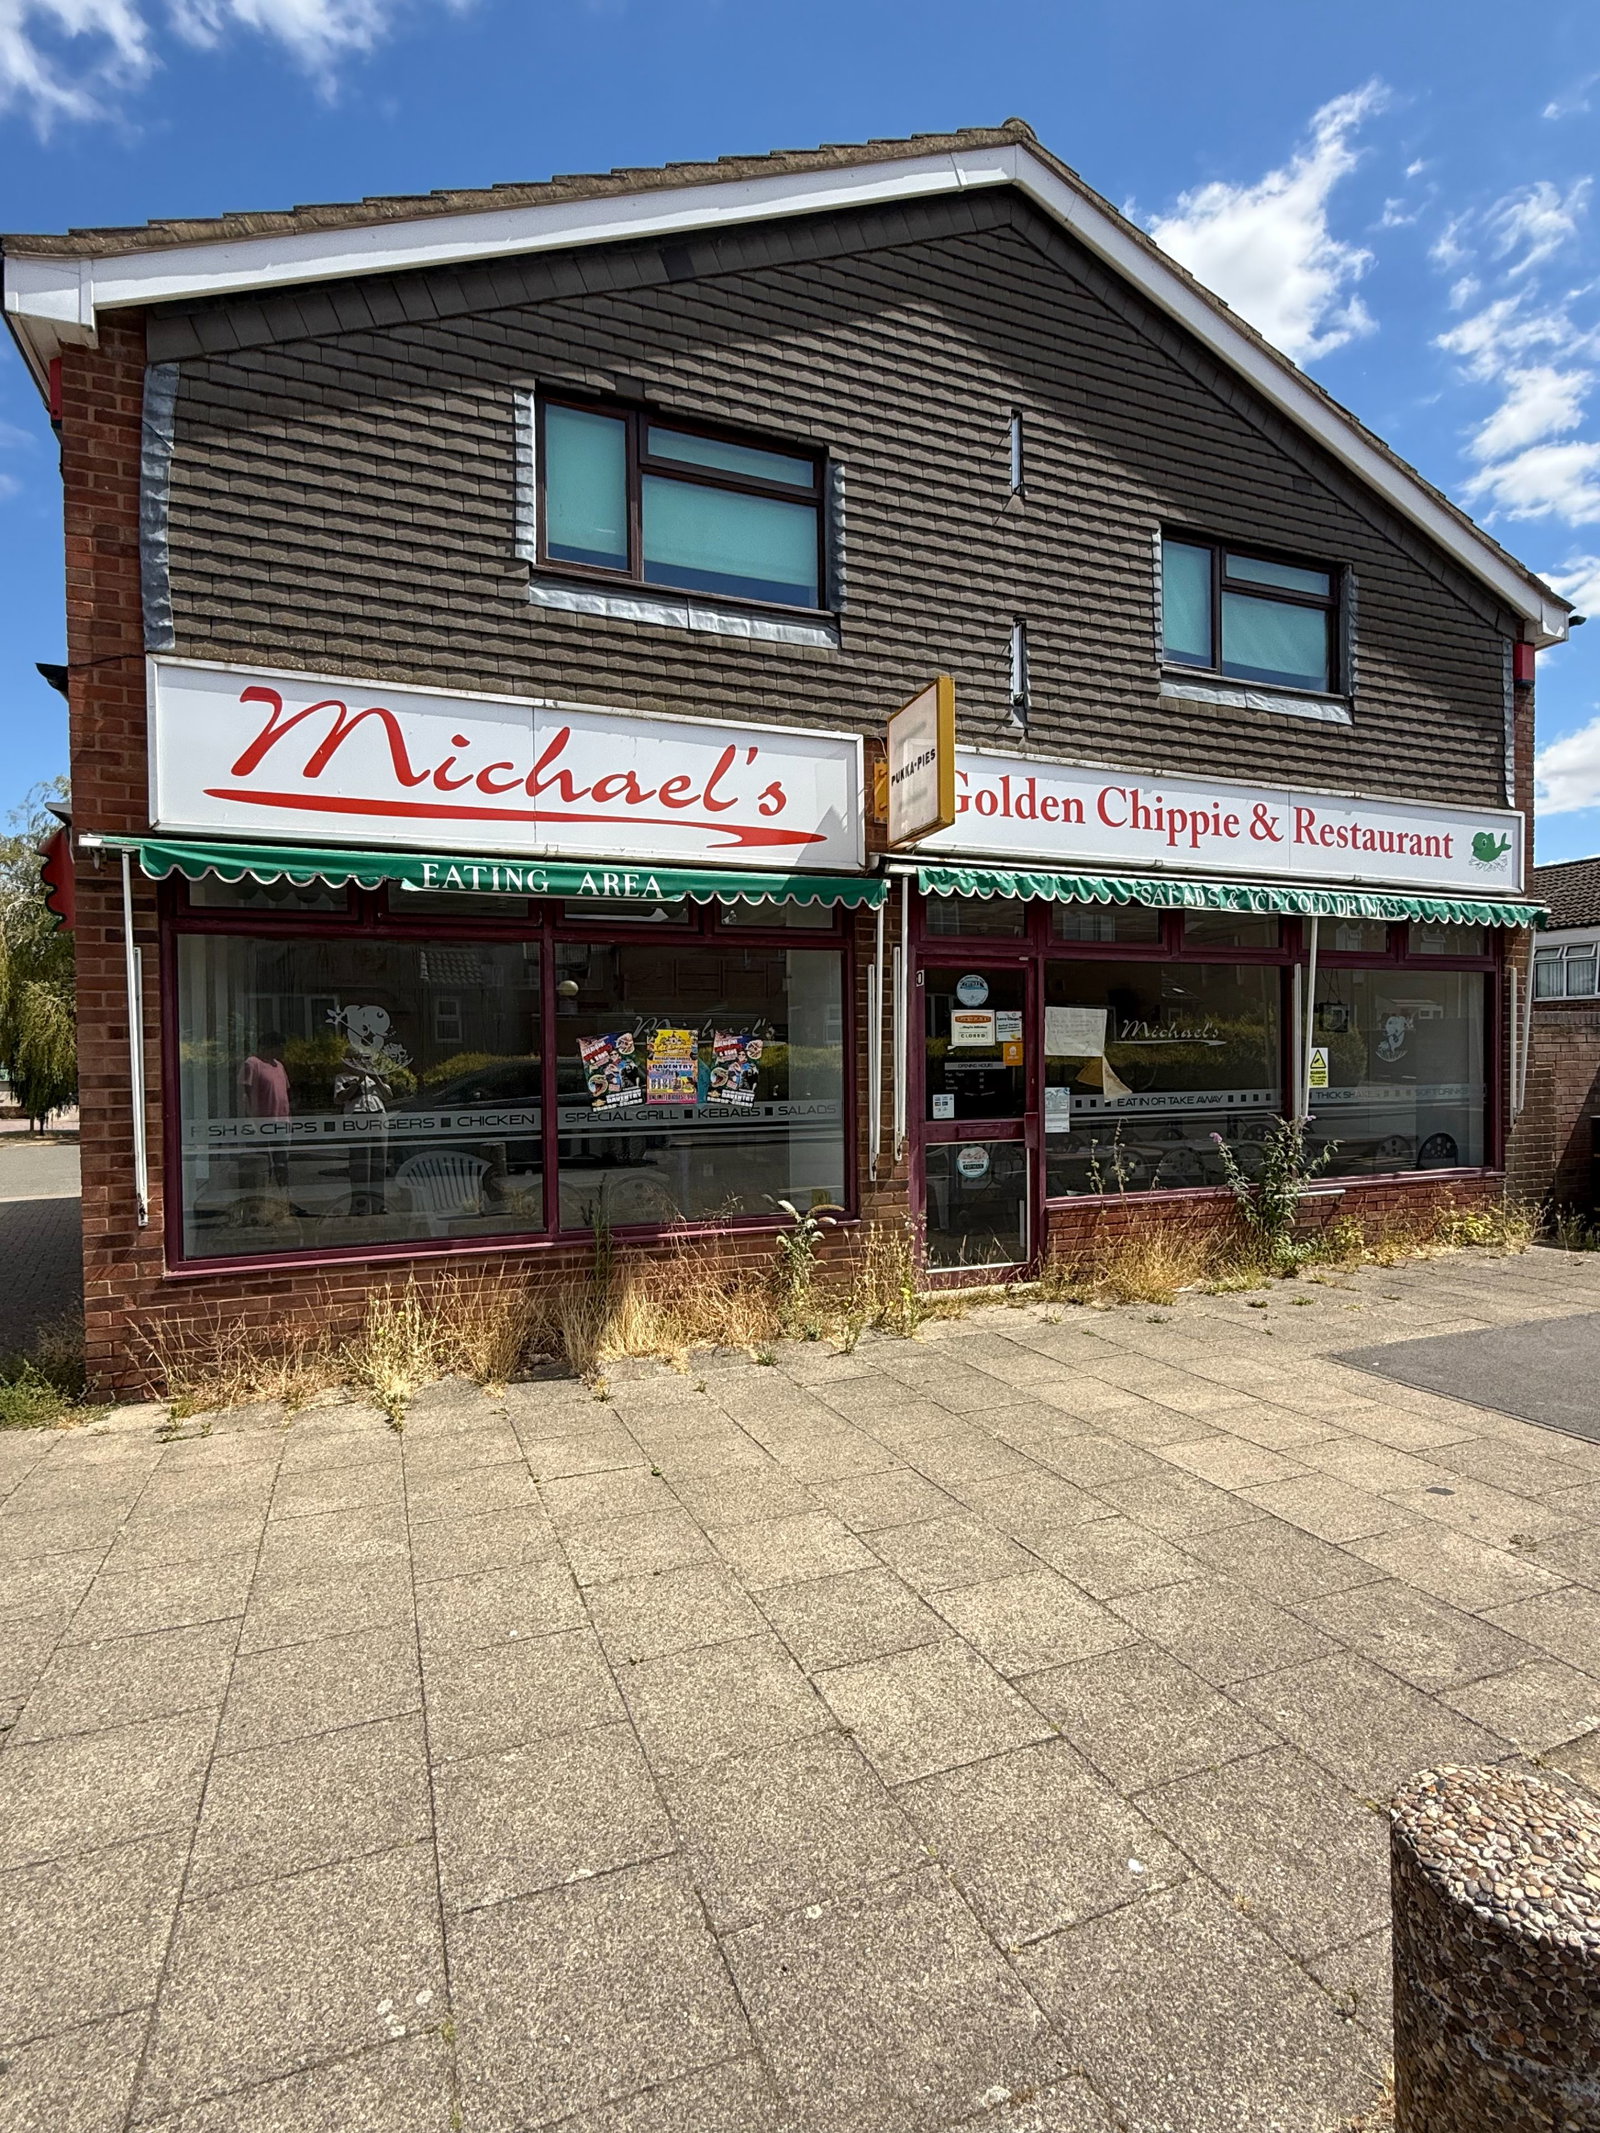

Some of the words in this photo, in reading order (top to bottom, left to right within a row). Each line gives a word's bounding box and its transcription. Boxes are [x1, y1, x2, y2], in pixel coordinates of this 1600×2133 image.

[231, 686, 787, 816] Michael's
[1097, 786, 1240, 848] Chippie
[1249, 803, 1284, 843] &
[1293, 806, 1454, 859] Restaurant
[420, 863, 550, 893] EATING
[576, 871, 665, 899] AREA
[1140, 885, 1220, 907] SALADS
[1226, 892, 1240, 909] &
[1250, 892, 1281, 912] ICE
[1285, 893, 1331, 915] COLD
[1335, 896, 1399, 919] DRINKS
[1121, 1019, 1220, 1039] Michael's
[1117, 1097, 1137, 1107] EAT
[1139, 1097, 1150, 1106] IN
[1150, 1096, 1166, 1105] OR
[1167, 1095, 1195, 1105] TAKE
[1195, 1094, 1223, 1104] AWAY
[1316, 1091, 1343, 1100] THICK
[564, 1110, 633, 1123] SPECIAL
[635, 1109, 680, 1121] GRILL
[698, 1106, 761, 1119] KEBABS
[777, 1104, 838, 1116] SALADS
[241, 1124, 256, 1136] &
[259, 1121, 318, 1135] CHIPS
[342, 1117, 436, 1132] BURGERS
[456, 1114, 535, 1128] CHICKEN
